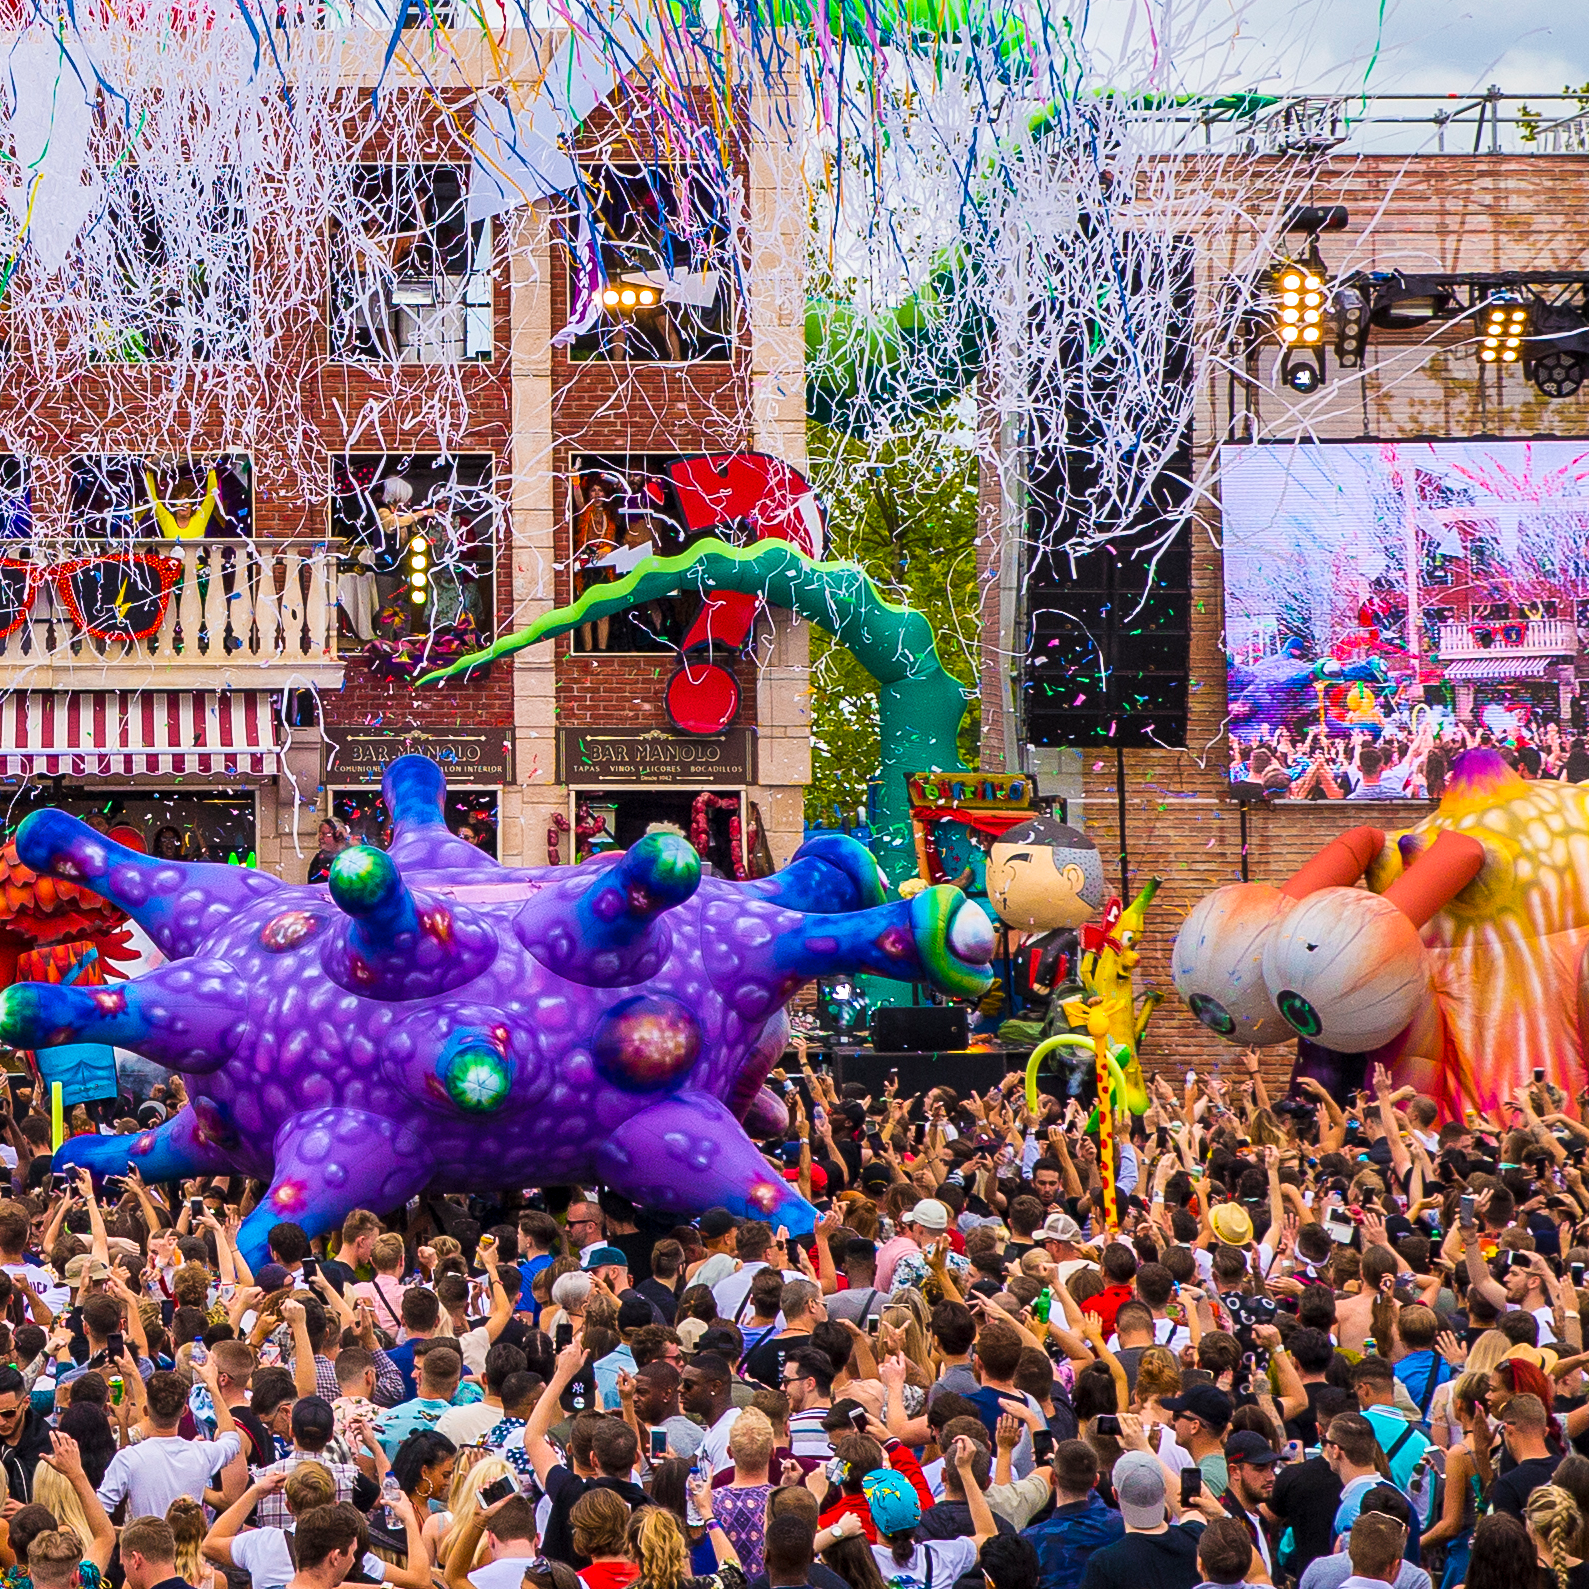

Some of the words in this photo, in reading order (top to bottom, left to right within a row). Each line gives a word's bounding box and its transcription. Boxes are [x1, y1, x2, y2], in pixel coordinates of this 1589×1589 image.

[351, 744, 390, 762] BAR
[396, 744, 481, 762] MANOLO
[590, 744, 630, 762] BAR
[634, 744, 721, 762] MANOLO
[333, 765, 384, 773] COMUNIONE
[464, 765, 503, 773] INTERIOR
[573, 765, 601, 773] TAPAS
[609, 765, 636, 773] VINOS
[638, 765, 644, 773] Y
[645, 765, 682, 773] LICORES
[690, 765, 743, 773] BOCADILLOS
